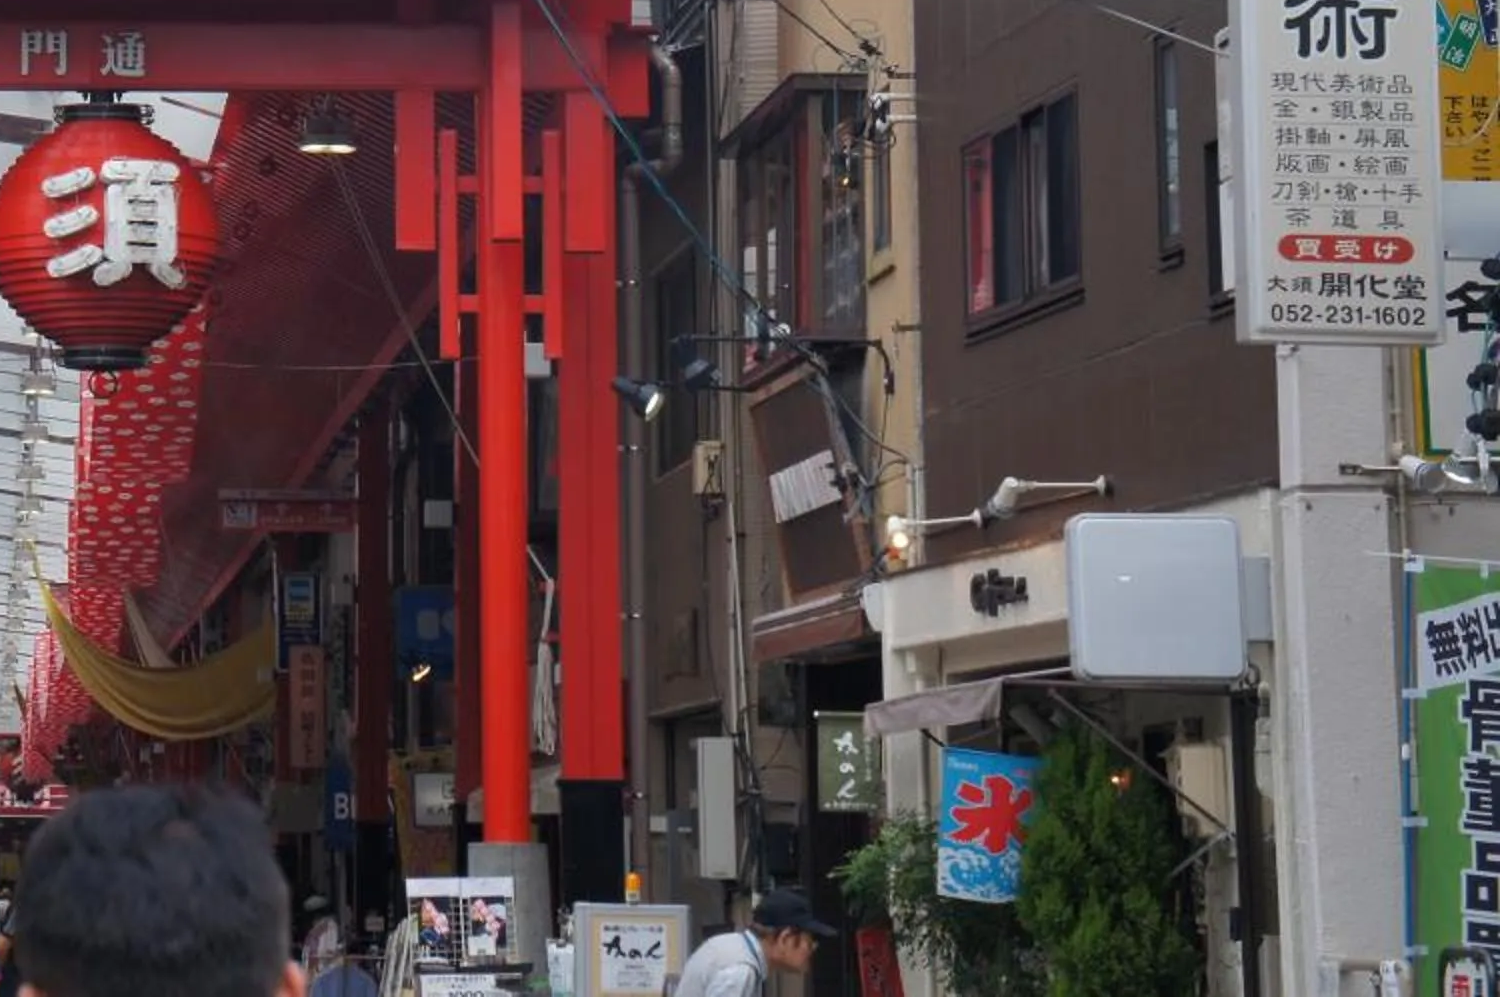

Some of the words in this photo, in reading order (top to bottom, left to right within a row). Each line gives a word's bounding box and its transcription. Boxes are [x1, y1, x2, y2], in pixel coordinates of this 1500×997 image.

[1271, 72, 1413, 94] 現代美術品
[41, 158, 189, 289] 須
[1285, 208, 1404, 229] 茶道具
[1294, 238, 1400, 260] 買受け
[1271, 304, 1425, 326] 052-231-1602
[950, 775, 1033, 855] 氷
